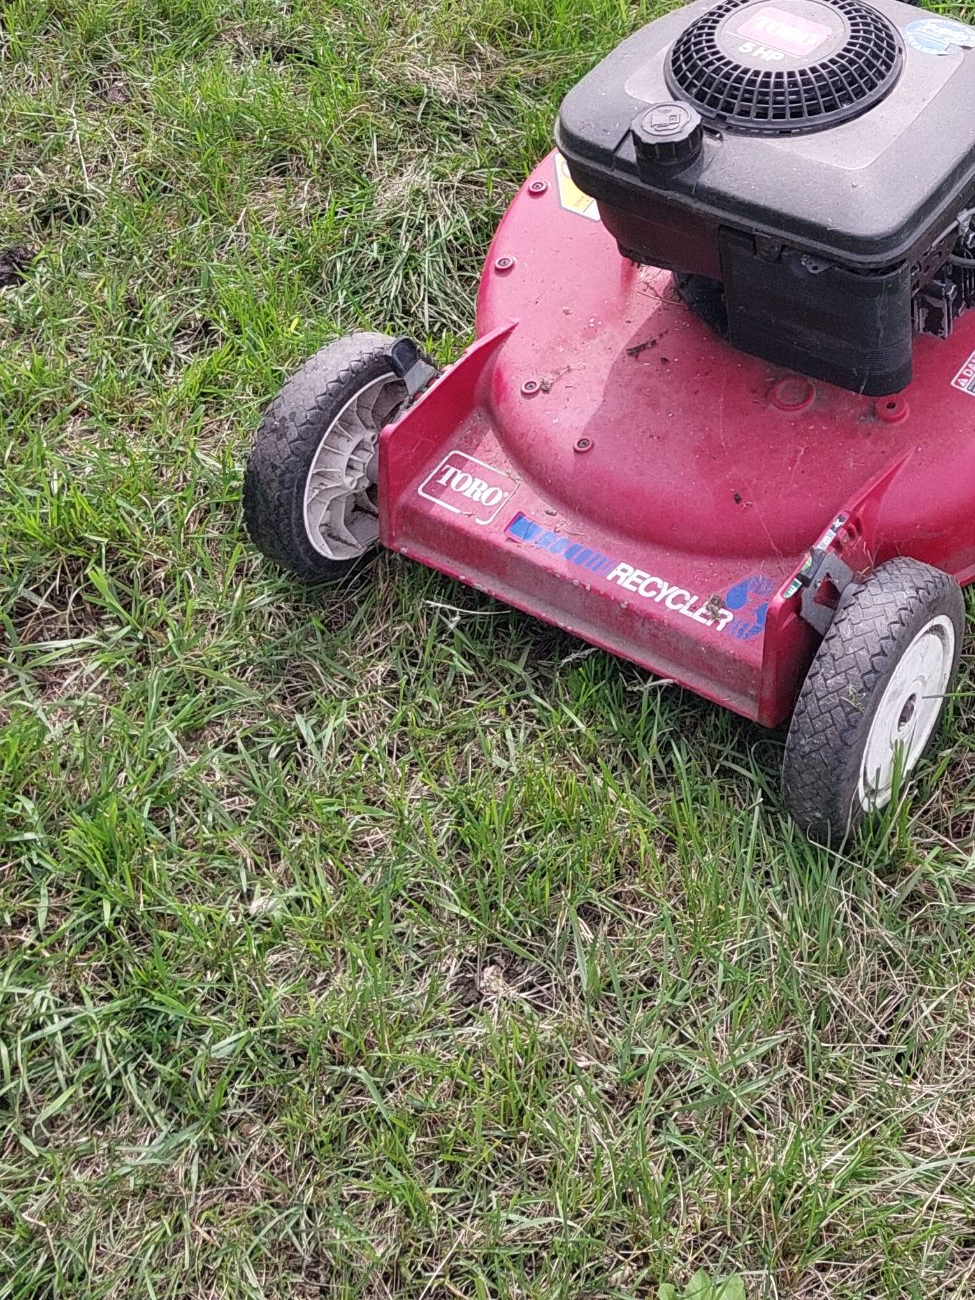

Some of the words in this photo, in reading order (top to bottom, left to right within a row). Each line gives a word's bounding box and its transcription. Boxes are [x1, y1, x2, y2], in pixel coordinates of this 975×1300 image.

[738, 41, 757, 53] 5
[752, 46, 785, 61] HP
[436, 464, 503, 507] TORO
[606, 562, 734, 632] RECYCLER
